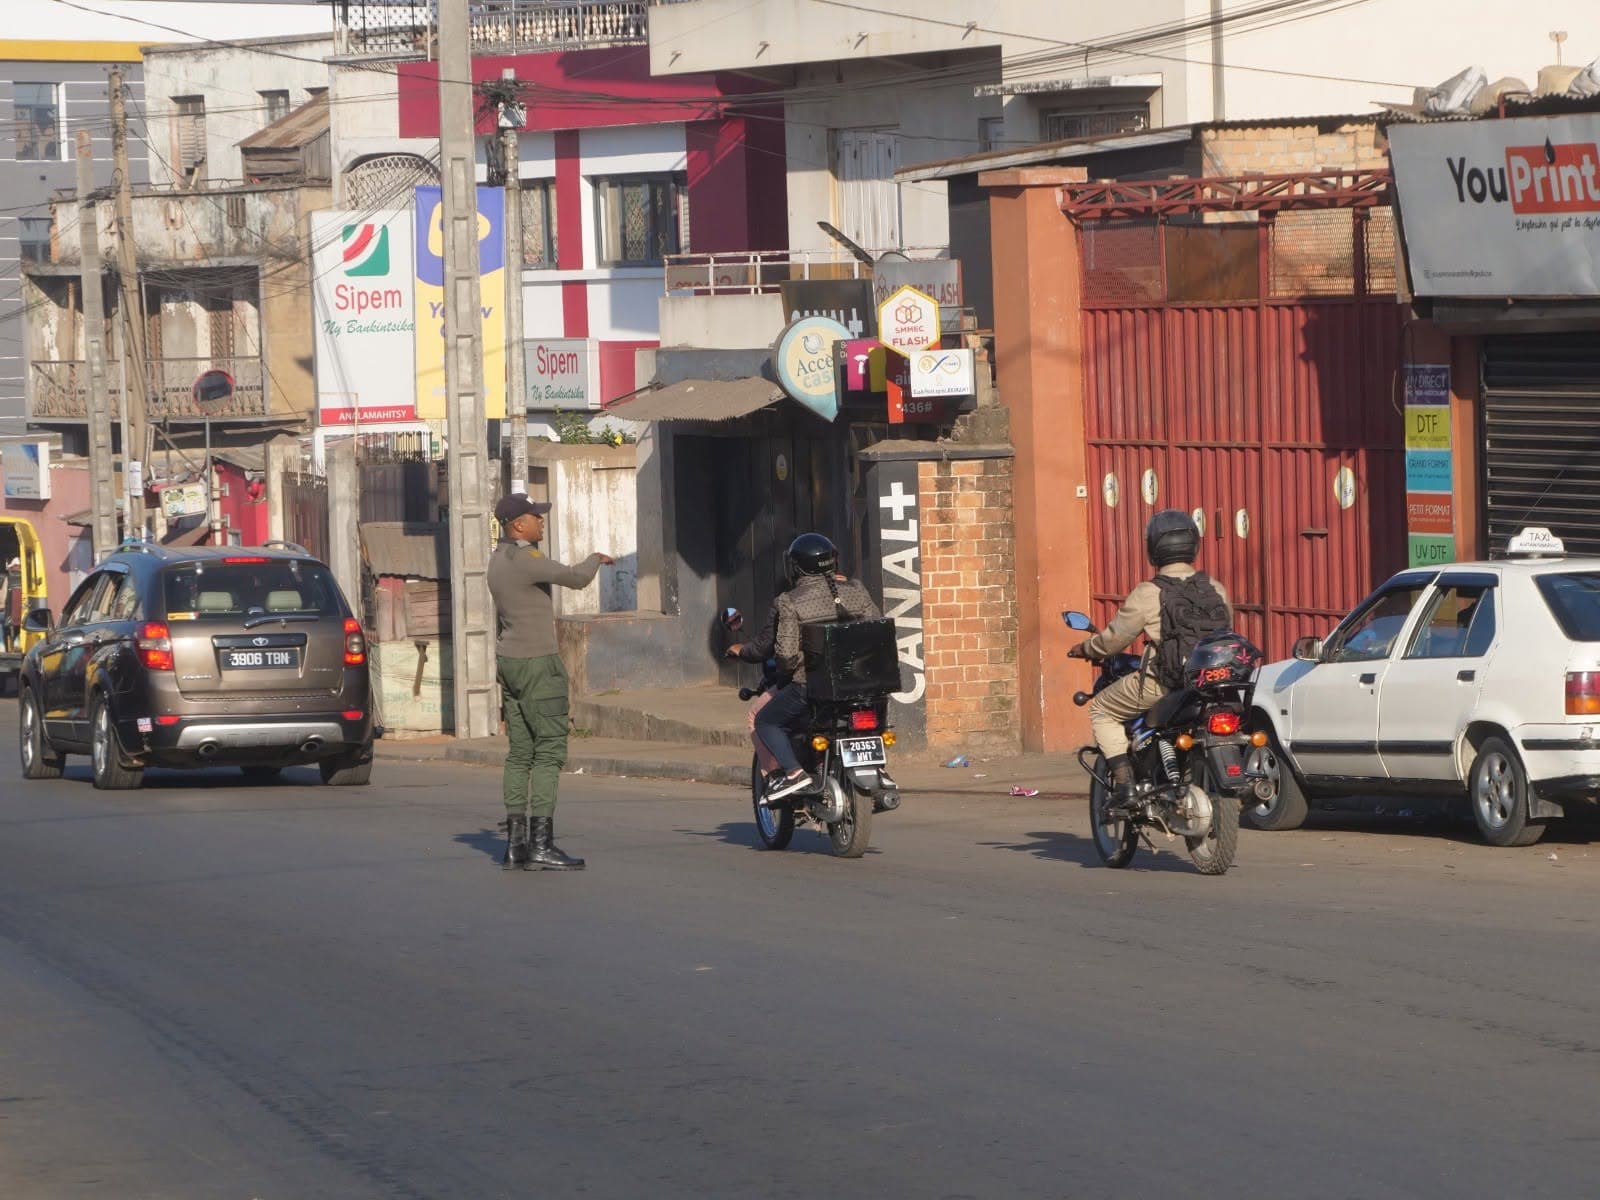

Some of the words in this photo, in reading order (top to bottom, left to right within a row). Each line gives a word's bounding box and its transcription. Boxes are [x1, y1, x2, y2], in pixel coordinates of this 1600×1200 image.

[335, 284, 402, 314] Sipem
[324, 319, 342, 337] Ny
[892, 336, 929, 346] FLASH
[537, 345, 578, 380] Sipem
[1417, 414, 1439, 433] DTF
[1528, 532, 1551, 542] TAXI
[1415, 544, 1428, 559] UV
[1430, 544, 1447, 560] DTF
[879, 482, 926, 704] CANAL+
[230, 652, 262, 666] 3906
[850, 740, 877, 751] 20363
